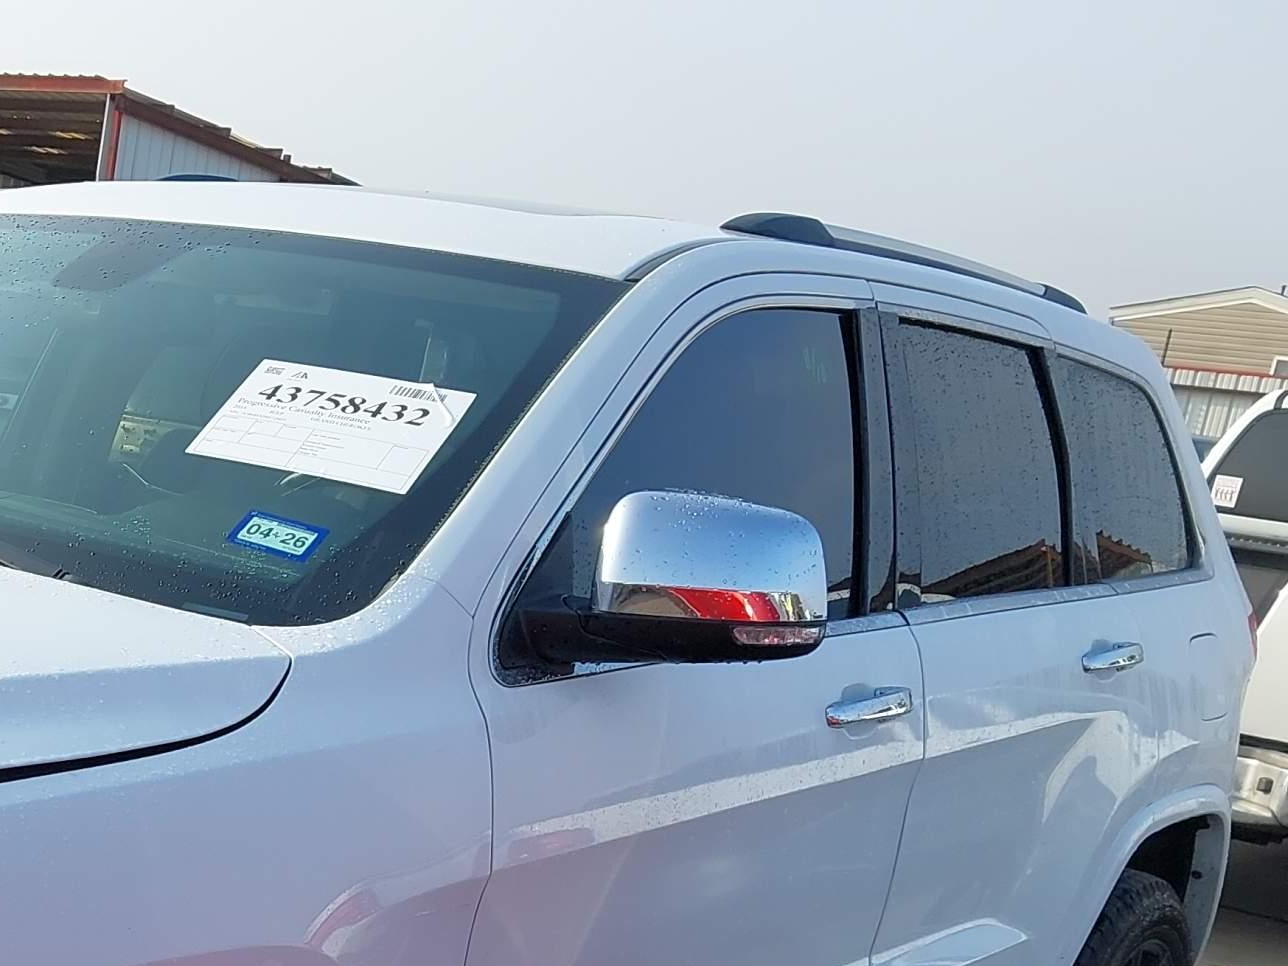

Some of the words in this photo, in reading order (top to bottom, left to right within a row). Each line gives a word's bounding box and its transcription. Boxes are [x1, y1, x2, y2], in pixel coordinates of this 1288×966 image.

[238, 397, 287, 411] Progressive
[289, 405, 324, 417] Casualty
[327, 411, 371, 425] Insurance
[258, 384, 430, 426] 43758432
[246, 523, 274, 539] 04
[279, 532, 309, 548] 26
